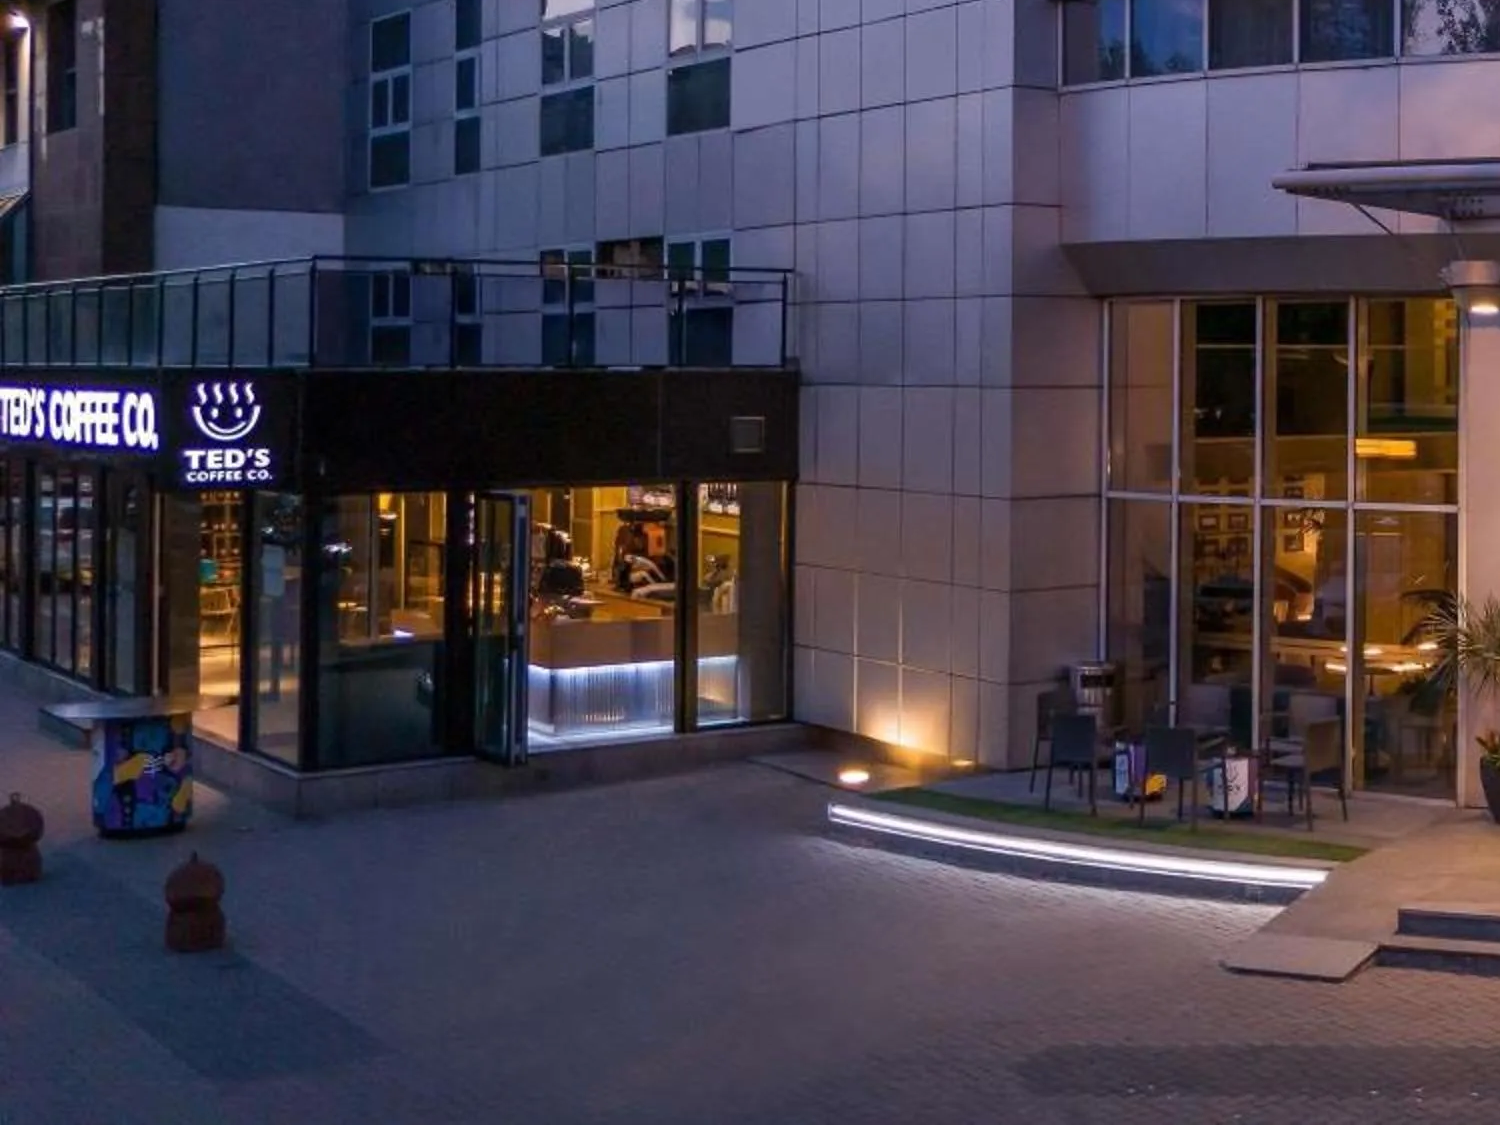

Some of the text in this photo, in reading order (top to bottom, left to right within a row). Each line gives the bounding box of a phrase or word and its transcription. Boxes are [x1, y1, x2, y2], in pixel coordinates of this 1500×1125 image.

[50, 389, 120, 446] COFFEE
[184, 448, 271, 470] TED'S
[186, 469, 273, 483] COFFEE CO.
